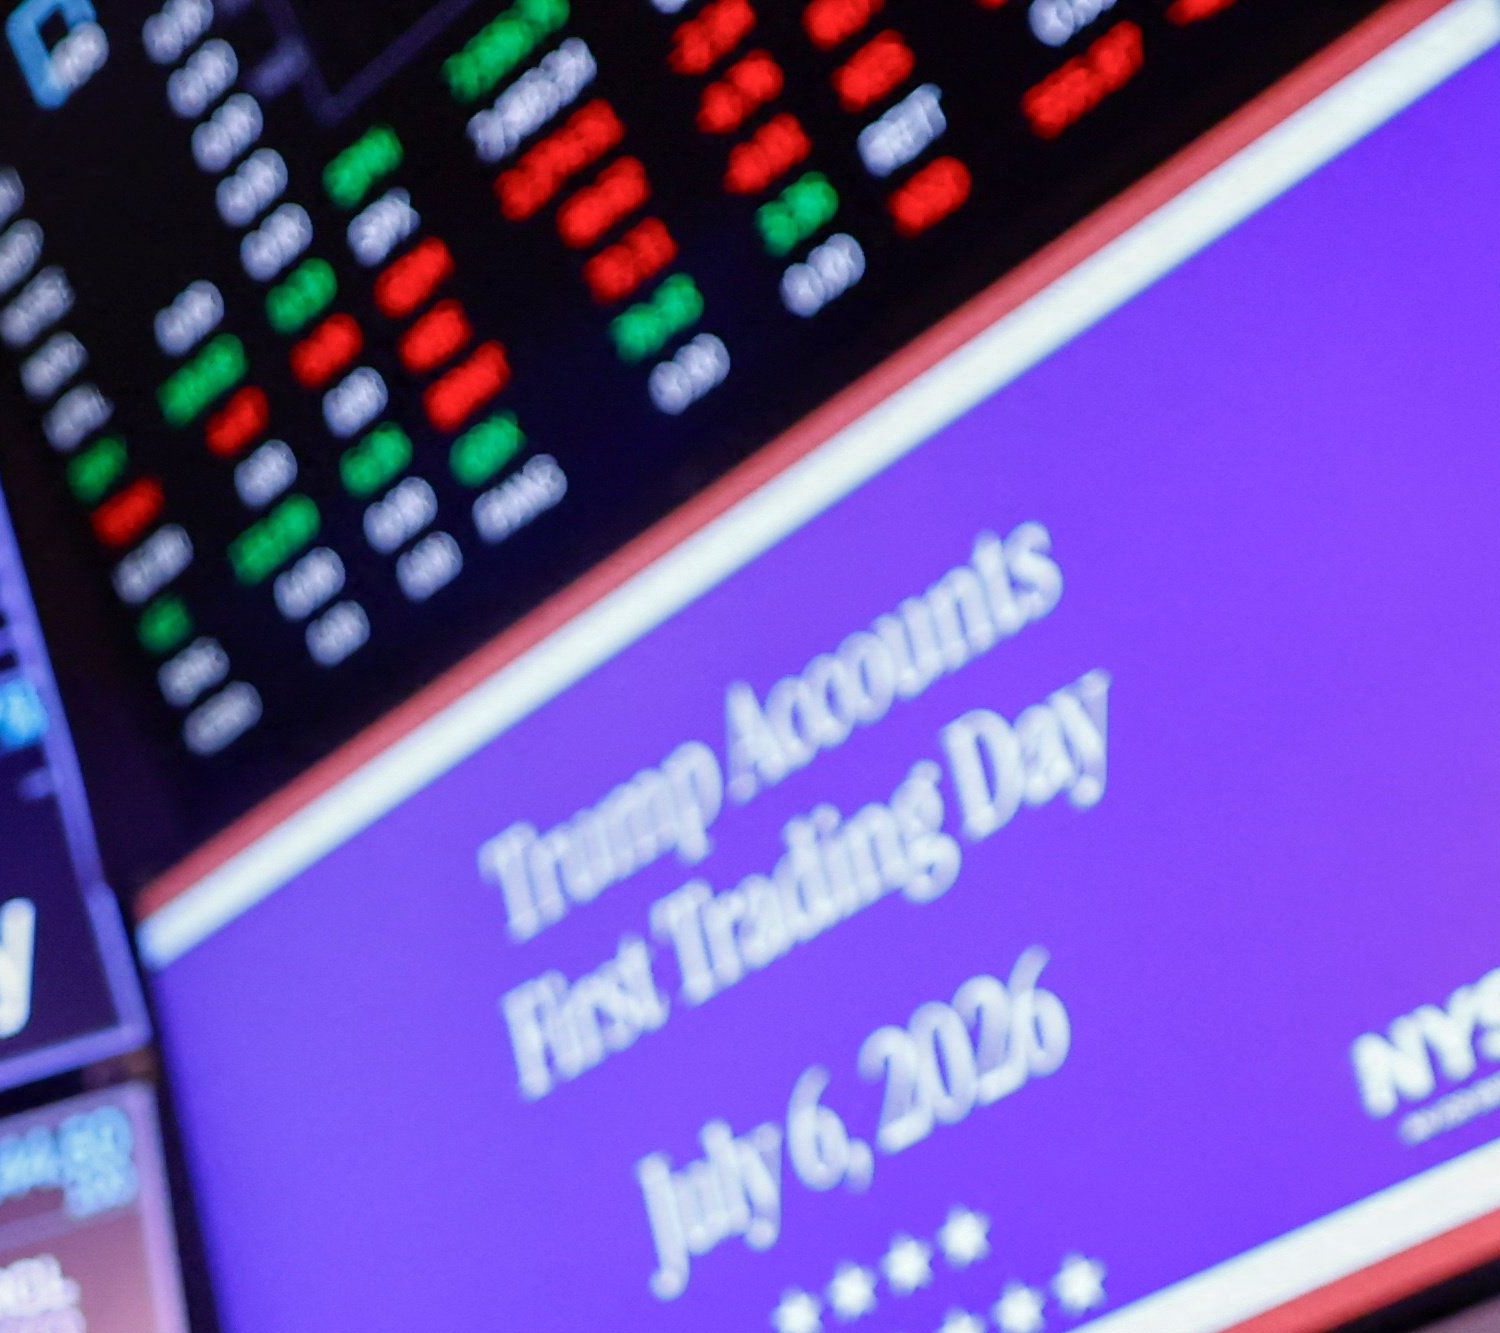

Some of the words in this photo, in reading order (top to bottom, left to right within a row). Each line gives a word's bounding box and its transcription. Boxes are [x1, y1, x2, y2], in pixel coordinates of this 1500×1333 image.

[480, 740, 724, 942] Trump
[726, 521, 1064, 804] Accounts
[501, 884, 669, 1101] First
[656, 756, 961, 1004] Trading
[942, 670, 1112, 838] Day
[633, 1114, 788, 1301] July
[784, 1066, 874, 1198] 6,
[859, 946, 1073, 1152] 2026
